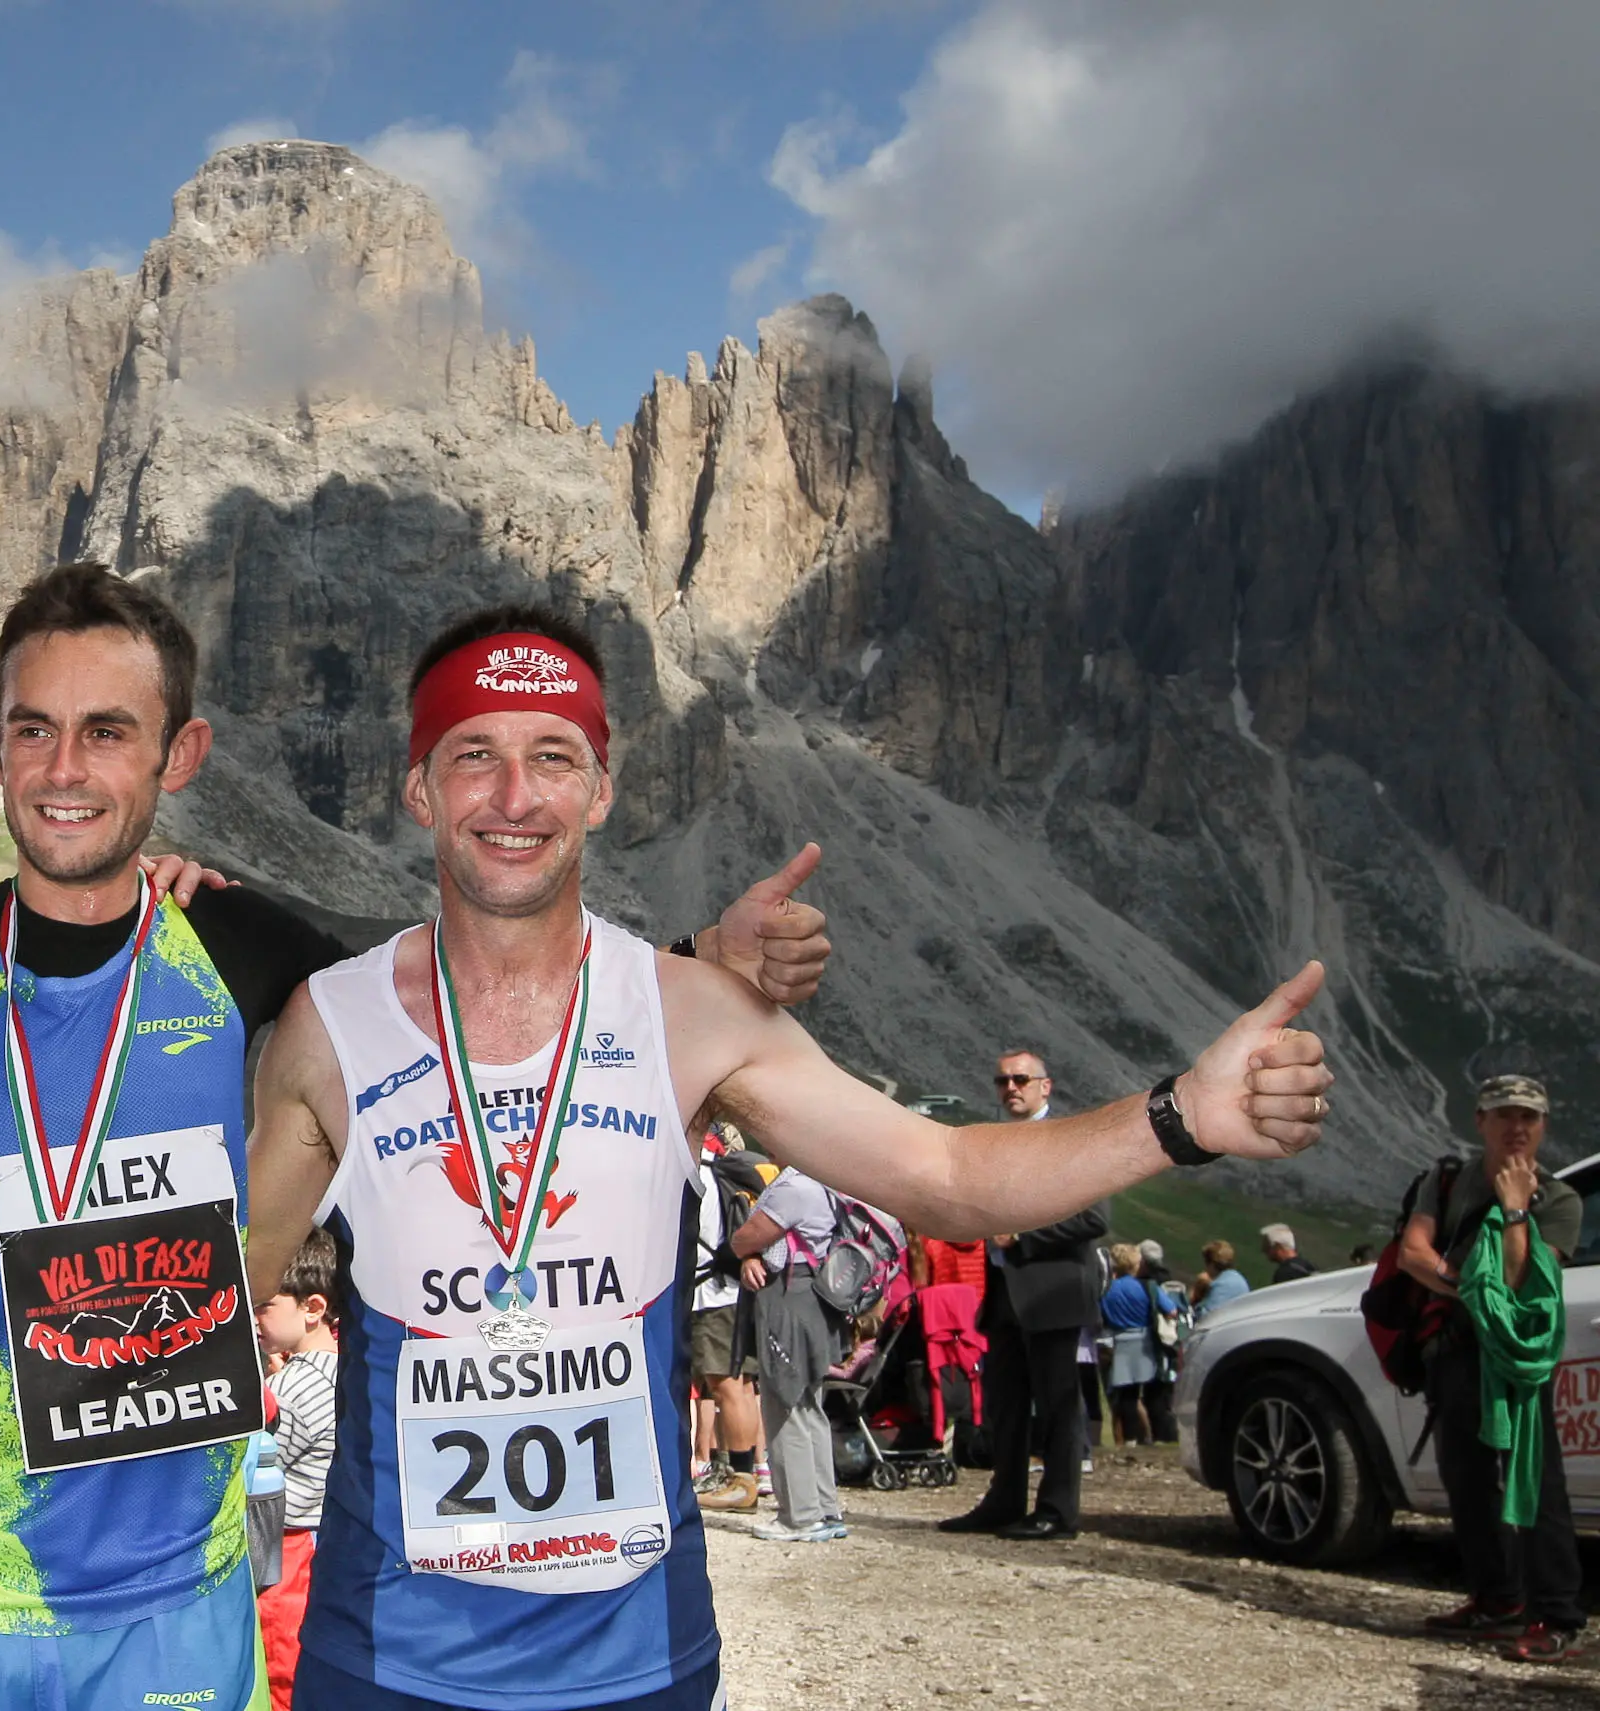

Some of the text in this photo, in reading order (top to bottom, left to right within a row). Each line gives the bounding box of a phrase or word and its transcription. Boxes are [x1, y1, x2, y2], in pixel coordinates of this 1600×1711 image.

[487, 648, 511, 667] VAL
[530, 649, 568, 673] FASSA
[475, 674, 578, 694] RUNNING
[136, 1014, 225, 1035] BROOKS
[397, 1059, 431, 1084] KARHU
[38, 1253, 92, 1301] VAL
[132, 1236, 213, 1283] FASSA
[24, 1284, 239, 1369] RUNNING
[412, 1341, 632, 1404] MASSIMO
[49, 1378, 238, 1441] LEADER
[431, 1416, 616, 1516] 201
[457, 1544, 501, 1570] FASSA
[508, 1532, 617, 1563] RUNNING
[623, 1541, 662, 1553] VOLVO
[143, 1689, 215, 1706] BROOKS
